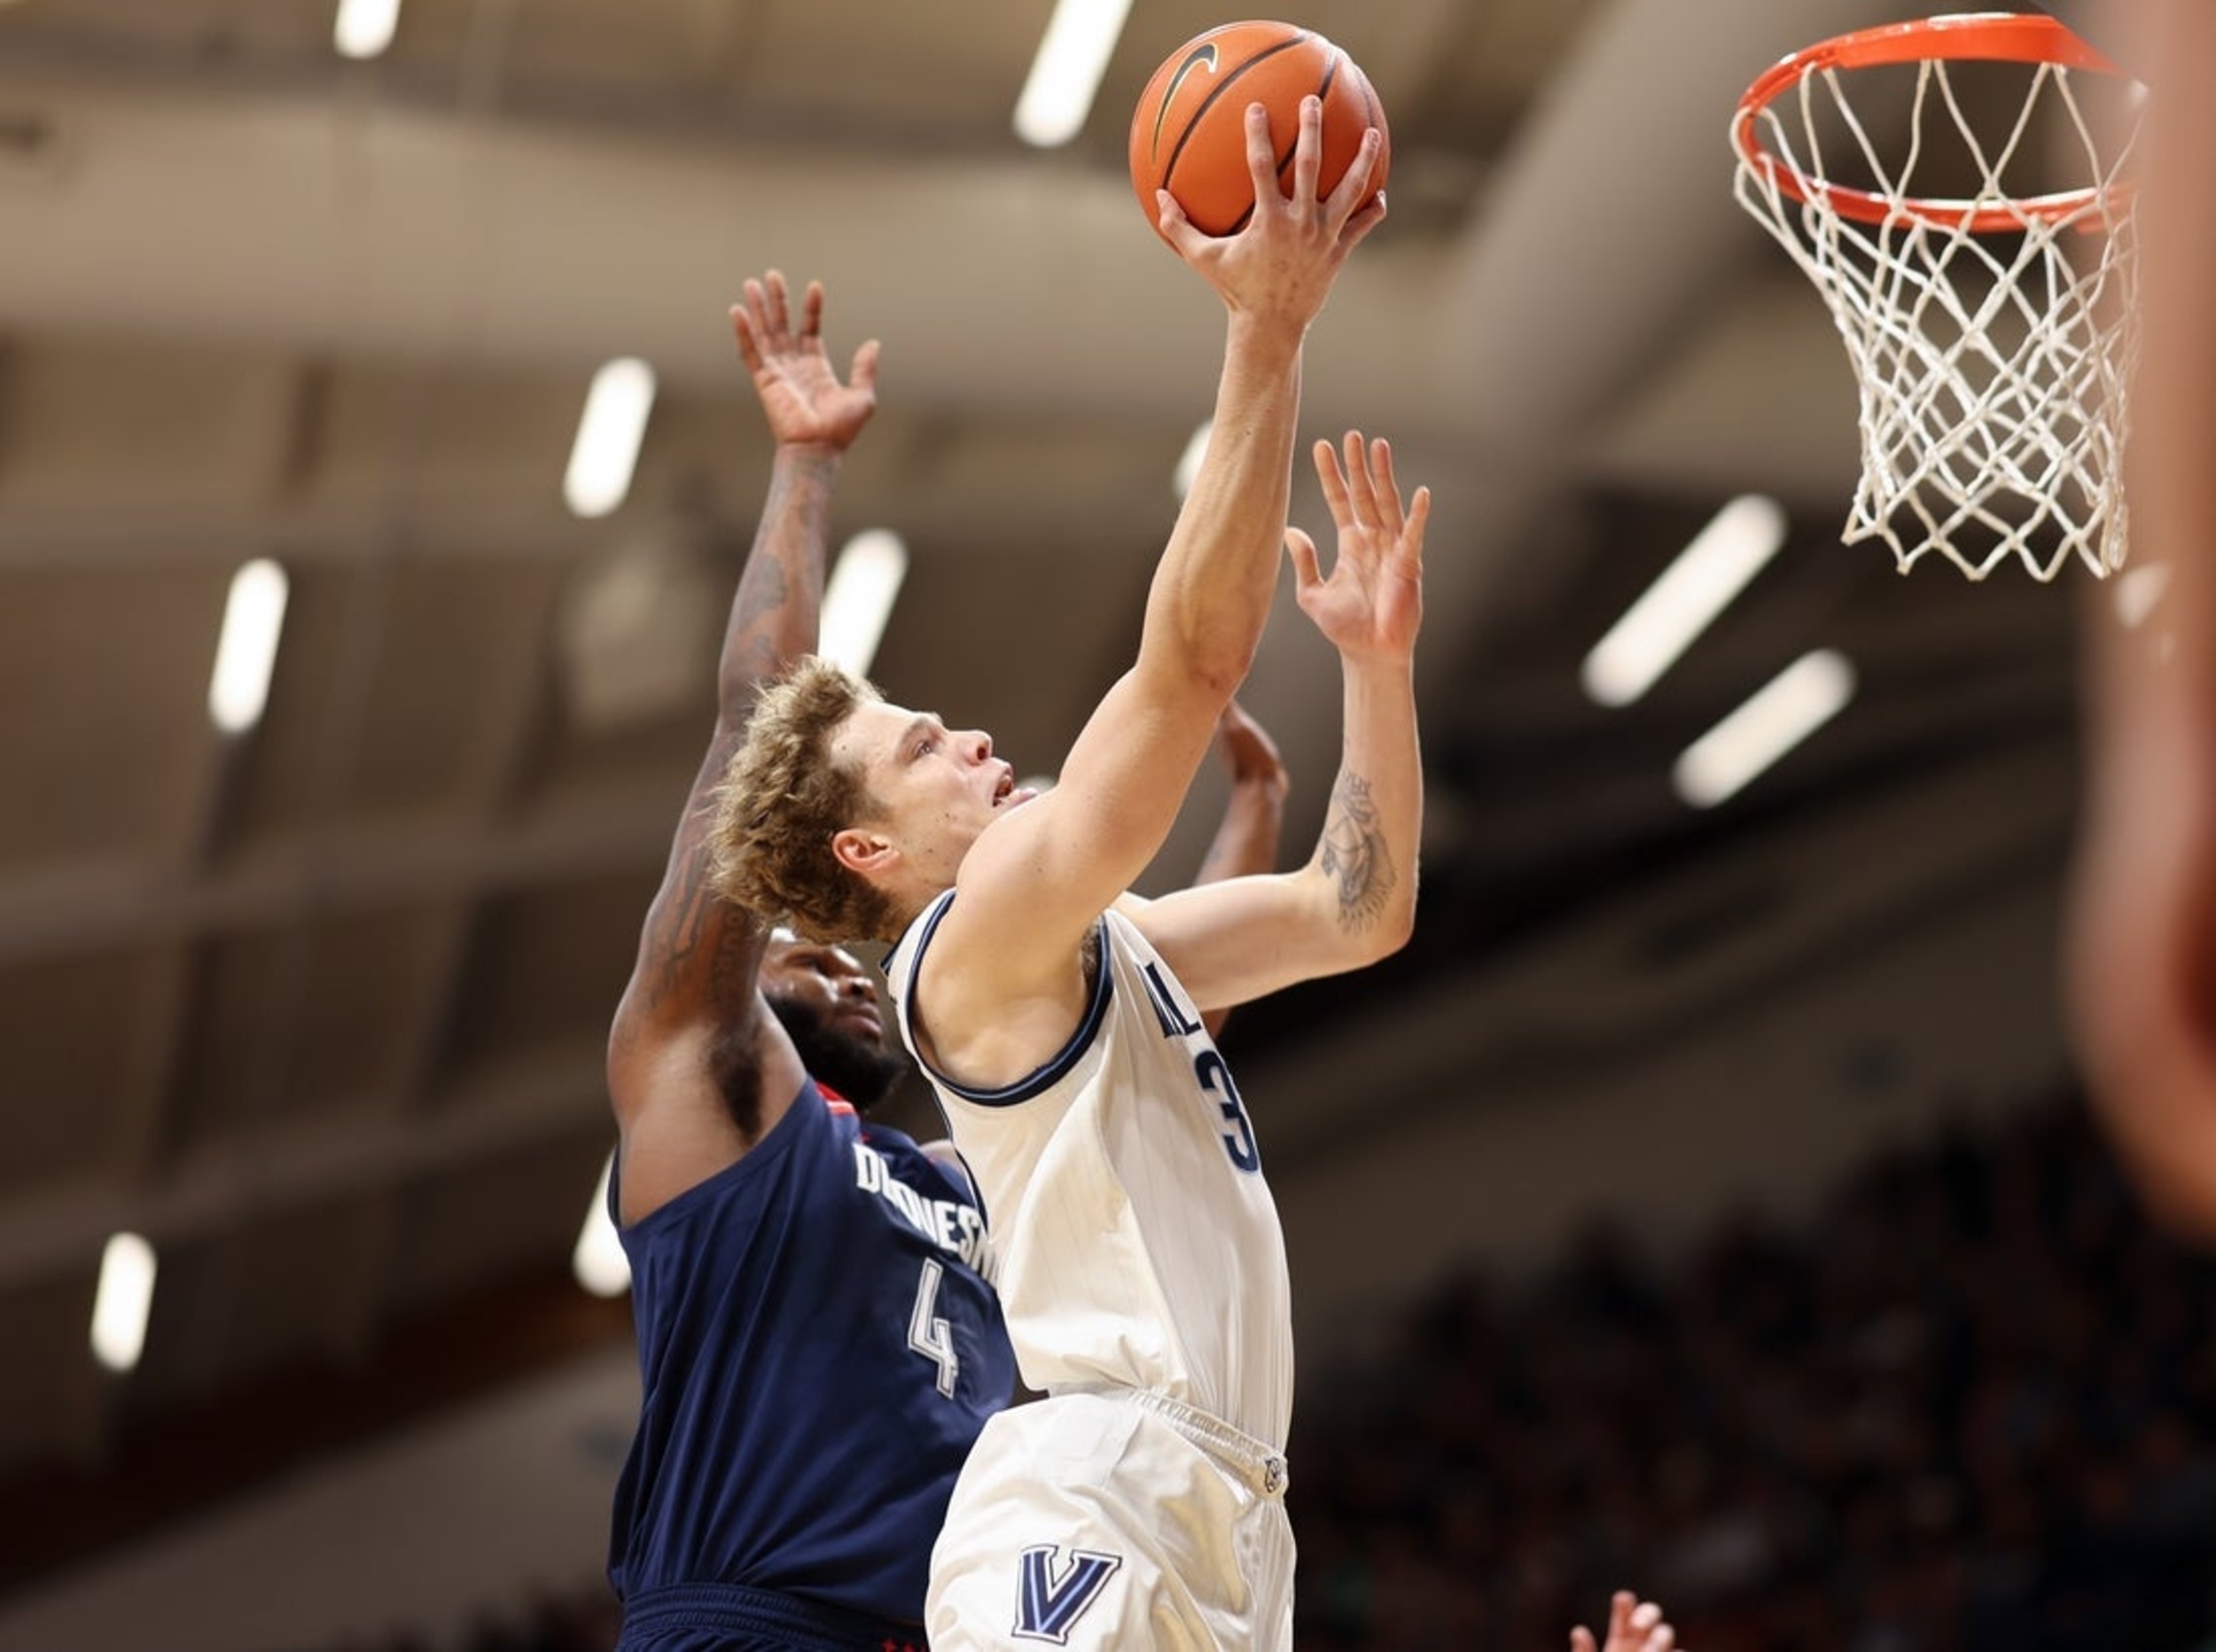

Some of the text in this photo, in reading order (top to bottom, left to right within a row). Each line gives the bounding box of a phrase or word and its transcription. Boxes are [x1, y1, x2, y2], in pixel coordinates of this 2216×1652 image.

[1194, 1049, 1259, 1172] 3
[908, 1257, 959, 1399] 4
[1011, 1543, 1123, 1647] V
